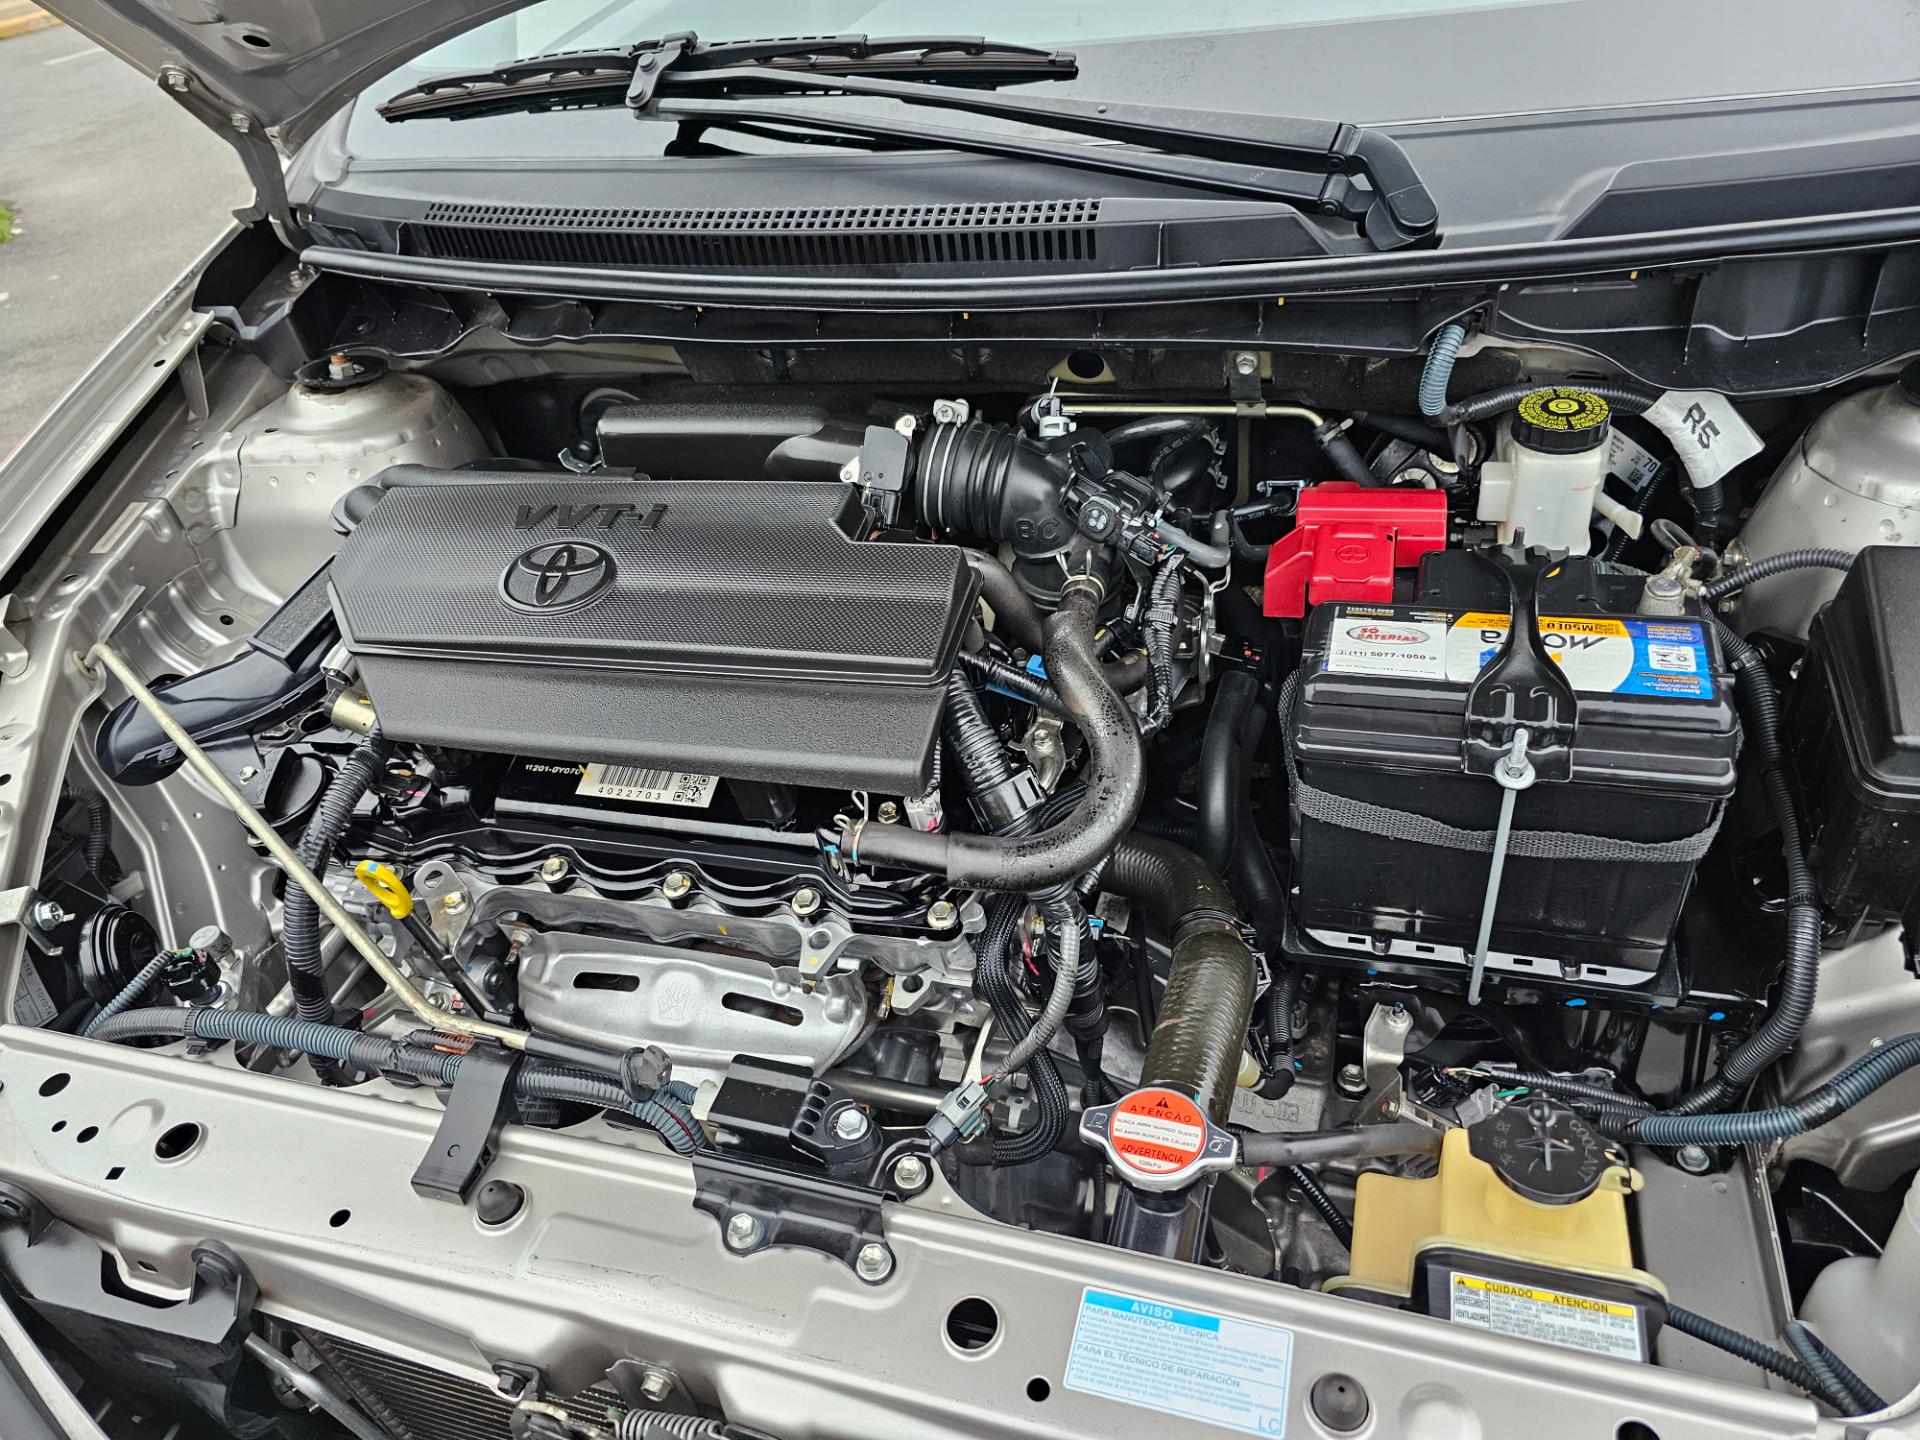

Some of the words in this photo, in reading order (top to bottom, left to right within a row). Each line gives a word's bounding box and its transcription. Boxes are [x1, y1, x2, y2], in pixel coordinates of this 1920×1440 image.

[1681, 402, 1721, 450] R5
[1642, 458, 1658, 473] 70
[1370, 651, 1427, 660] 5077-1050
[597, 786, 662, 801] 4022703
[1484, 1282, 1534, 1299] CUIDADO
[1085, 1305, 1109, 1316] PARA
[1130, 1301, 1174, 1319] AVISO
[1077, 1343, 1102, 1357] PARA
[1103, 1349, 1116, 1360] EL
[1161, 1362, 1175, 1374] DE
[1257, 1415, 1280, 1434] LC
